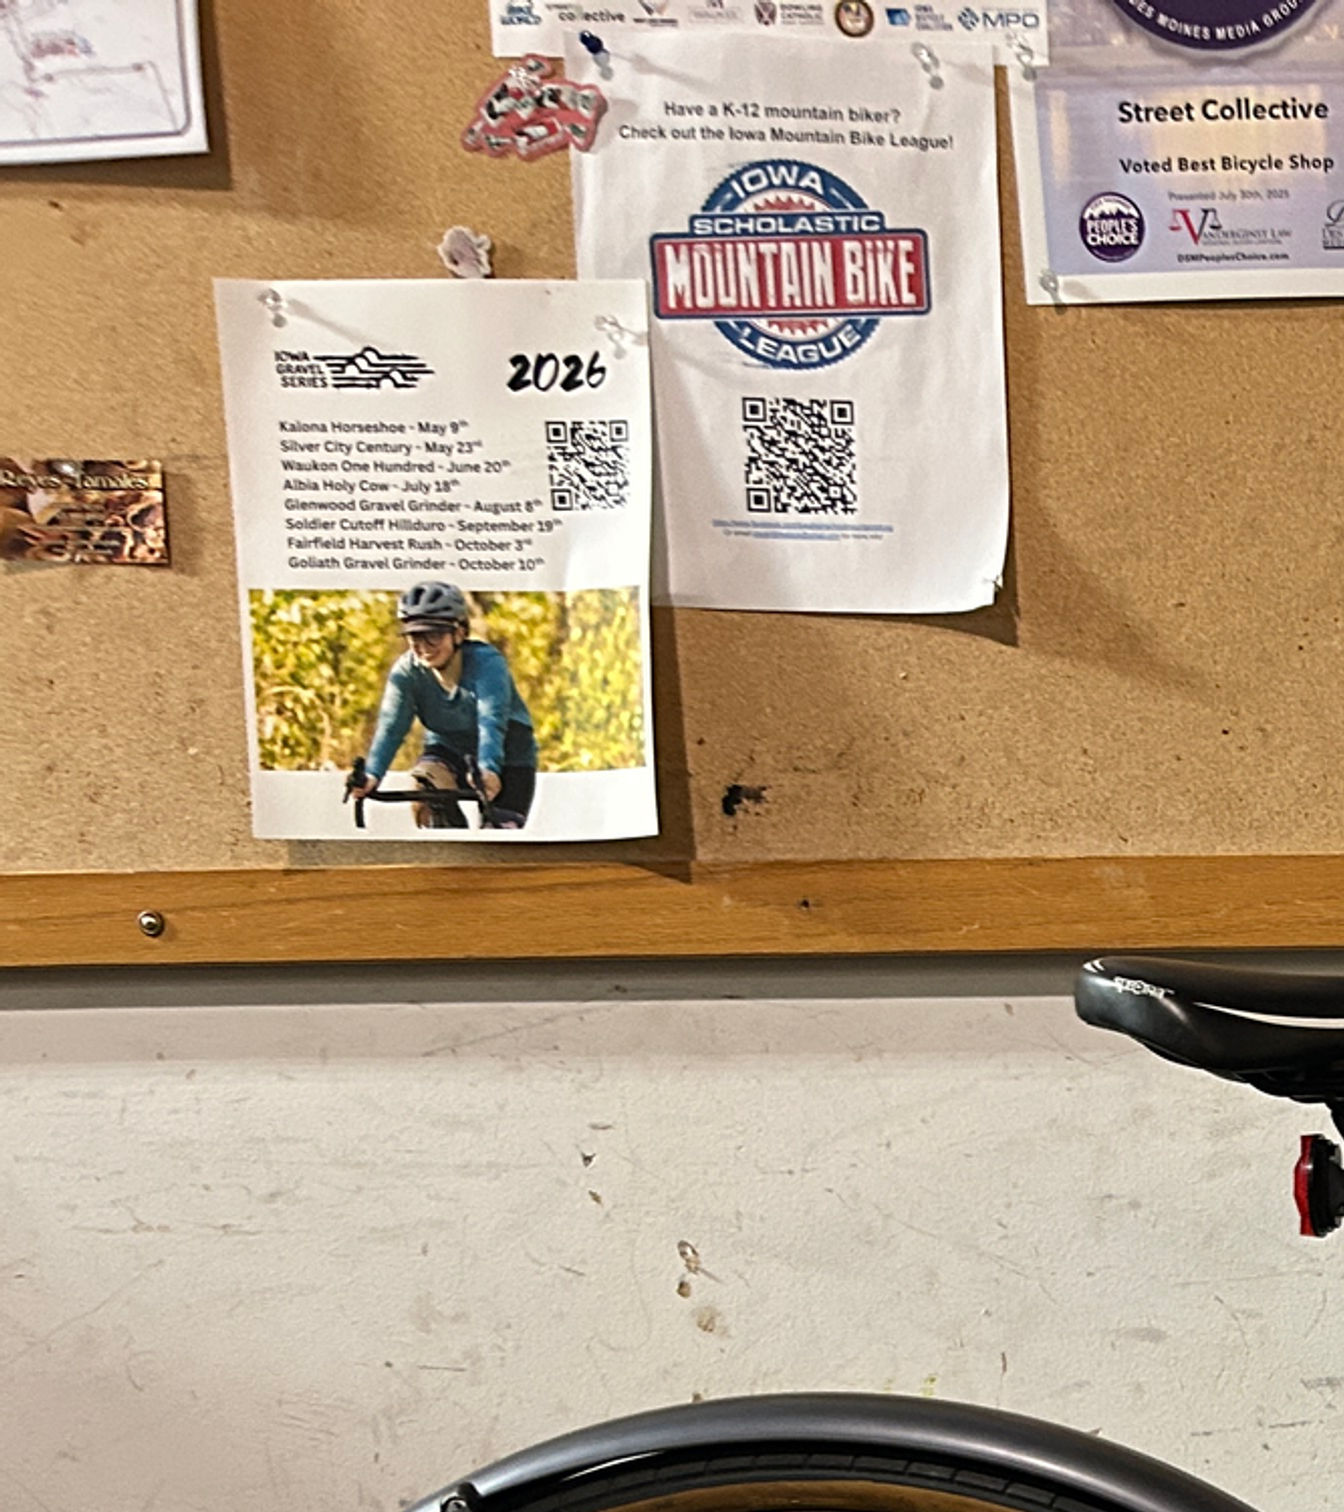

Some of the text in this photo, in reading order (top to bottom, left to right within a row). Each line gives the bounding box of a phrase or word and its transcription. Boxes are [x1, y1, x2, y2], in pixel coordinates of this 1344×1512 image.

[982, 13, 1040, 28] MPO
[1157, 14, 1211, 40] MOINES
[1216, 21, 1260, 40] MEDIA
[664, 102, 901, 124] Have a K-12 mountain biker?
[1118, 97, 1329, 123] Street Collective
[619, 125, 954, 151] Check out the Iowa Mountain Bike League!
[1119, 154, 1335, 174] Voted Best Bicycle Shop
[729, 166, 826, 200] IOWA
[1219, 190, 1238, 201] July
[693, 214, 882, 236] SCHOLASTIC
[1087, 218, 1140, 235] PEOPLE'S
[1087, 232, 1140, 247] CHOICE
[665, 240, 835, 310] MOUNTAIN
[738, 326, 862, 364] LEAGUE
[274, 351, 311, 363] IOWA
[276, 363, 324, 376] GRAVEL
[506, 351, 607, 392] 2026
[280, 375, 329, 388] SERIES
[332, 421, 406, 434] Horseshoe
[417, 422, 446, 437] May
[279, 439, 321, 453] Silver
[325, 440, 352, 456] City
[356, 441, 413, 457] Century
[424, 442, 452, 457] May
[281, 459, 338, 473] Waukon
[341, 460, 369, 473] One
[373, 460, 435, 474] Hundred
[447, 460, 480, 474] June
[483, 458, 512, 474] 20th
[323, 479, 355, 495] Holy
[359, 480, 389, 492] Cow
[402, 479, 431, 495] July
[284, 498, 357, 512] Glenwood
[360, 498, 407, 512] Gravel
[410, 499, 462, 513] Grinder
[474, 500, 522, 515] August
[285, 518, 336, 531] Soldier
[340, 518, 385, 532] Cutoff
[458, 519, 535, 535] September
[287, 537, 346, 551] Fairfield
[350, 537, 404, 551] Harvest
[407, 537, 442, 551] Rush
[454, 538, 511, 552] October
[288, 556, 340, 570] Goliath
[343, 556, 390, 570] Gravel
[393, 557, 446, 571] Grinder
[458, 557, 516, 571] October
